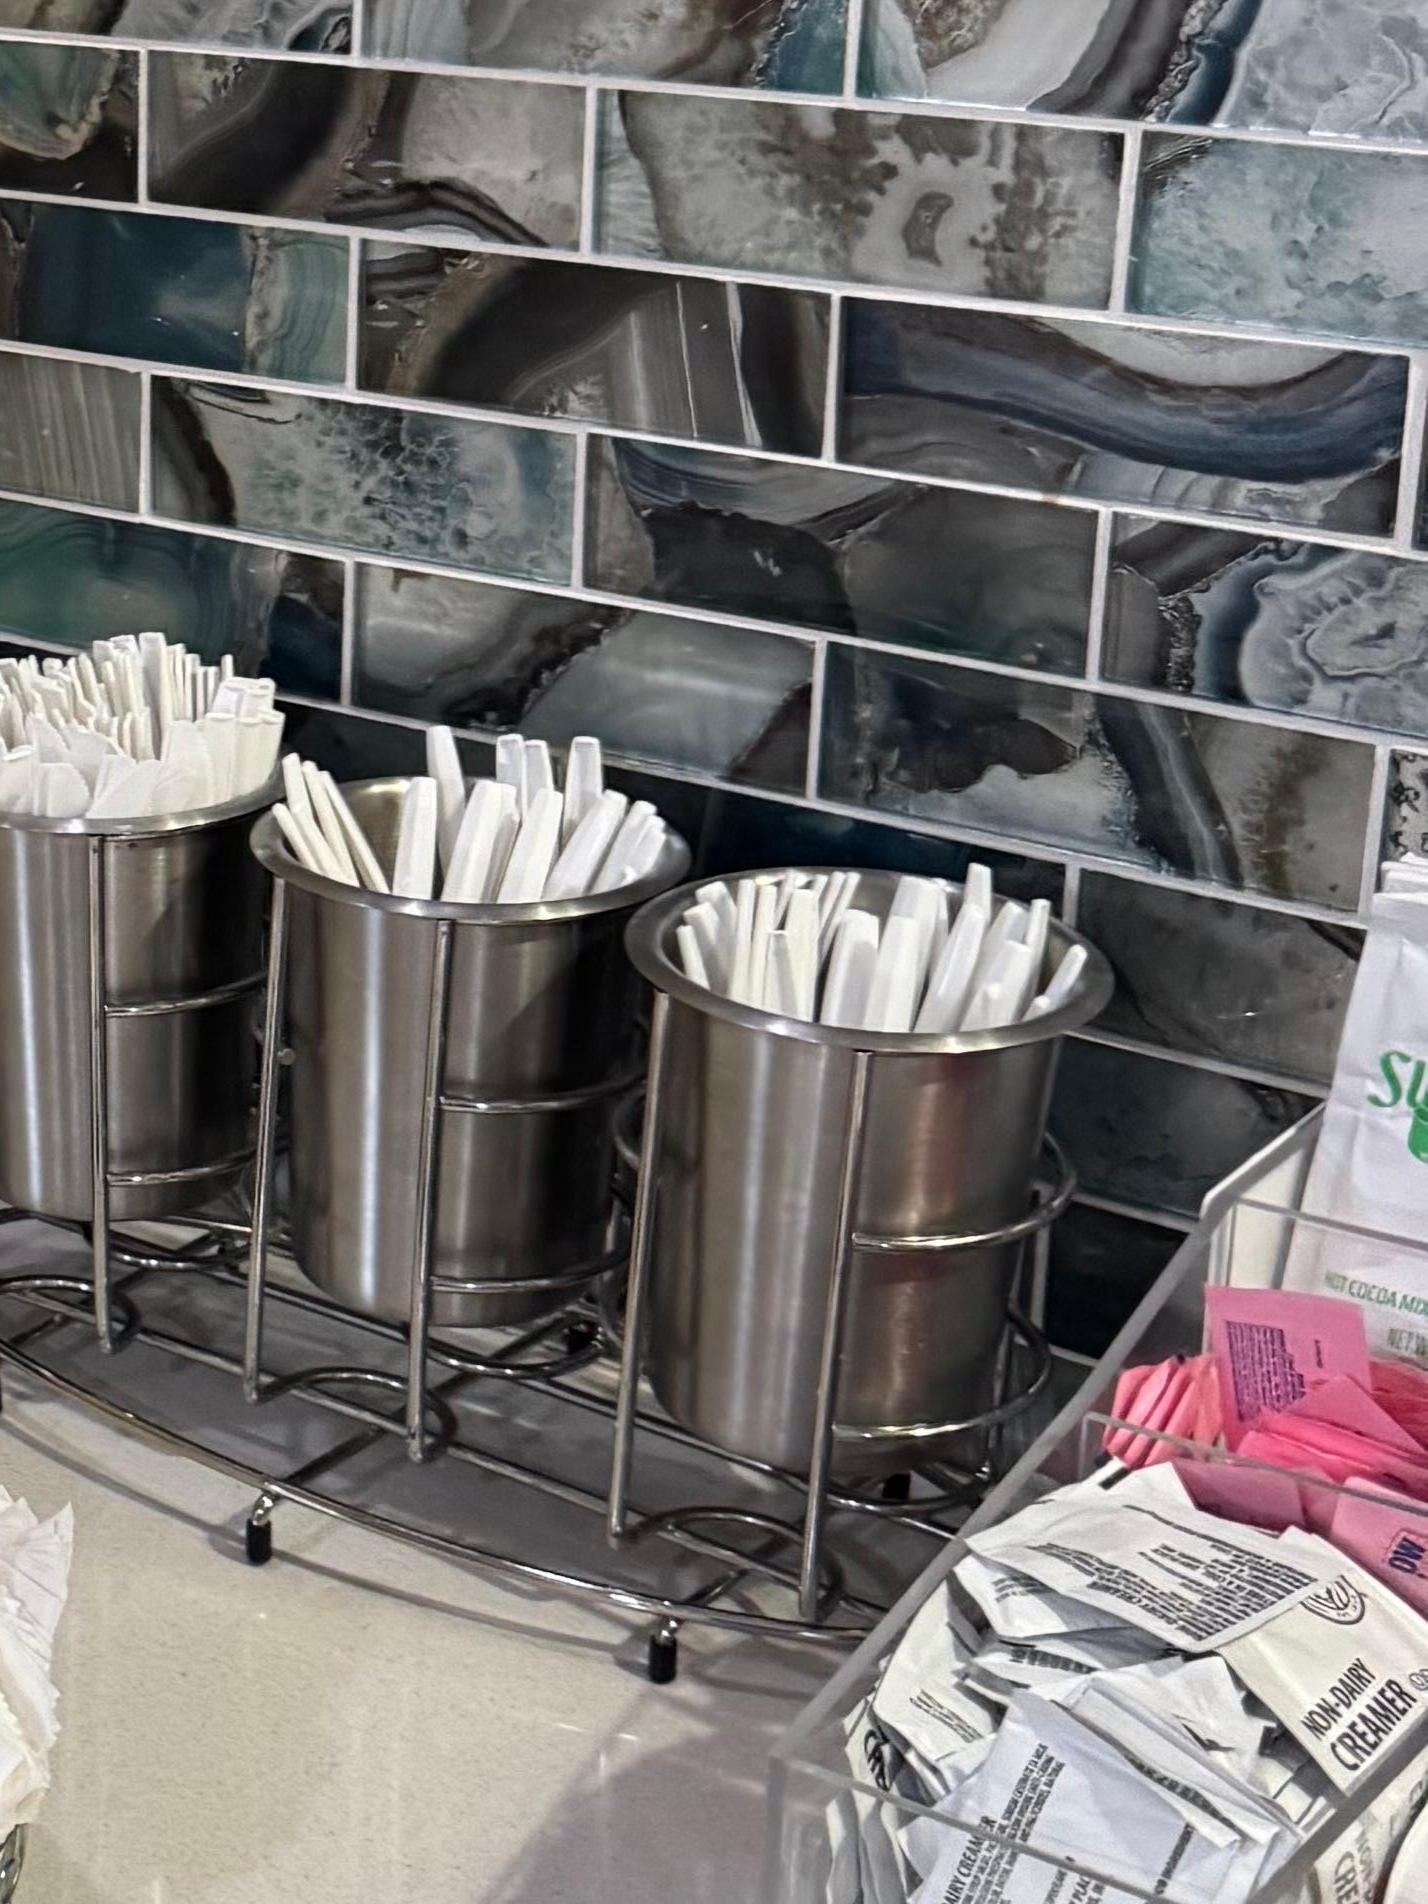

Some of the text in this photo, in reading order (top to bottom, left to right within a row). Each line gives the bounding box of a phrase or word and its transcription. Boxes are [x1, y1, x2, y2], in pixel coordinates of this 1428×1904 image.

[1300, 1657, 1377, 1741] NON-DAIRY
[1329, 1678, 1419, 1773] CREAMER
[1071, 1876, 1090, 1902] PLAC
